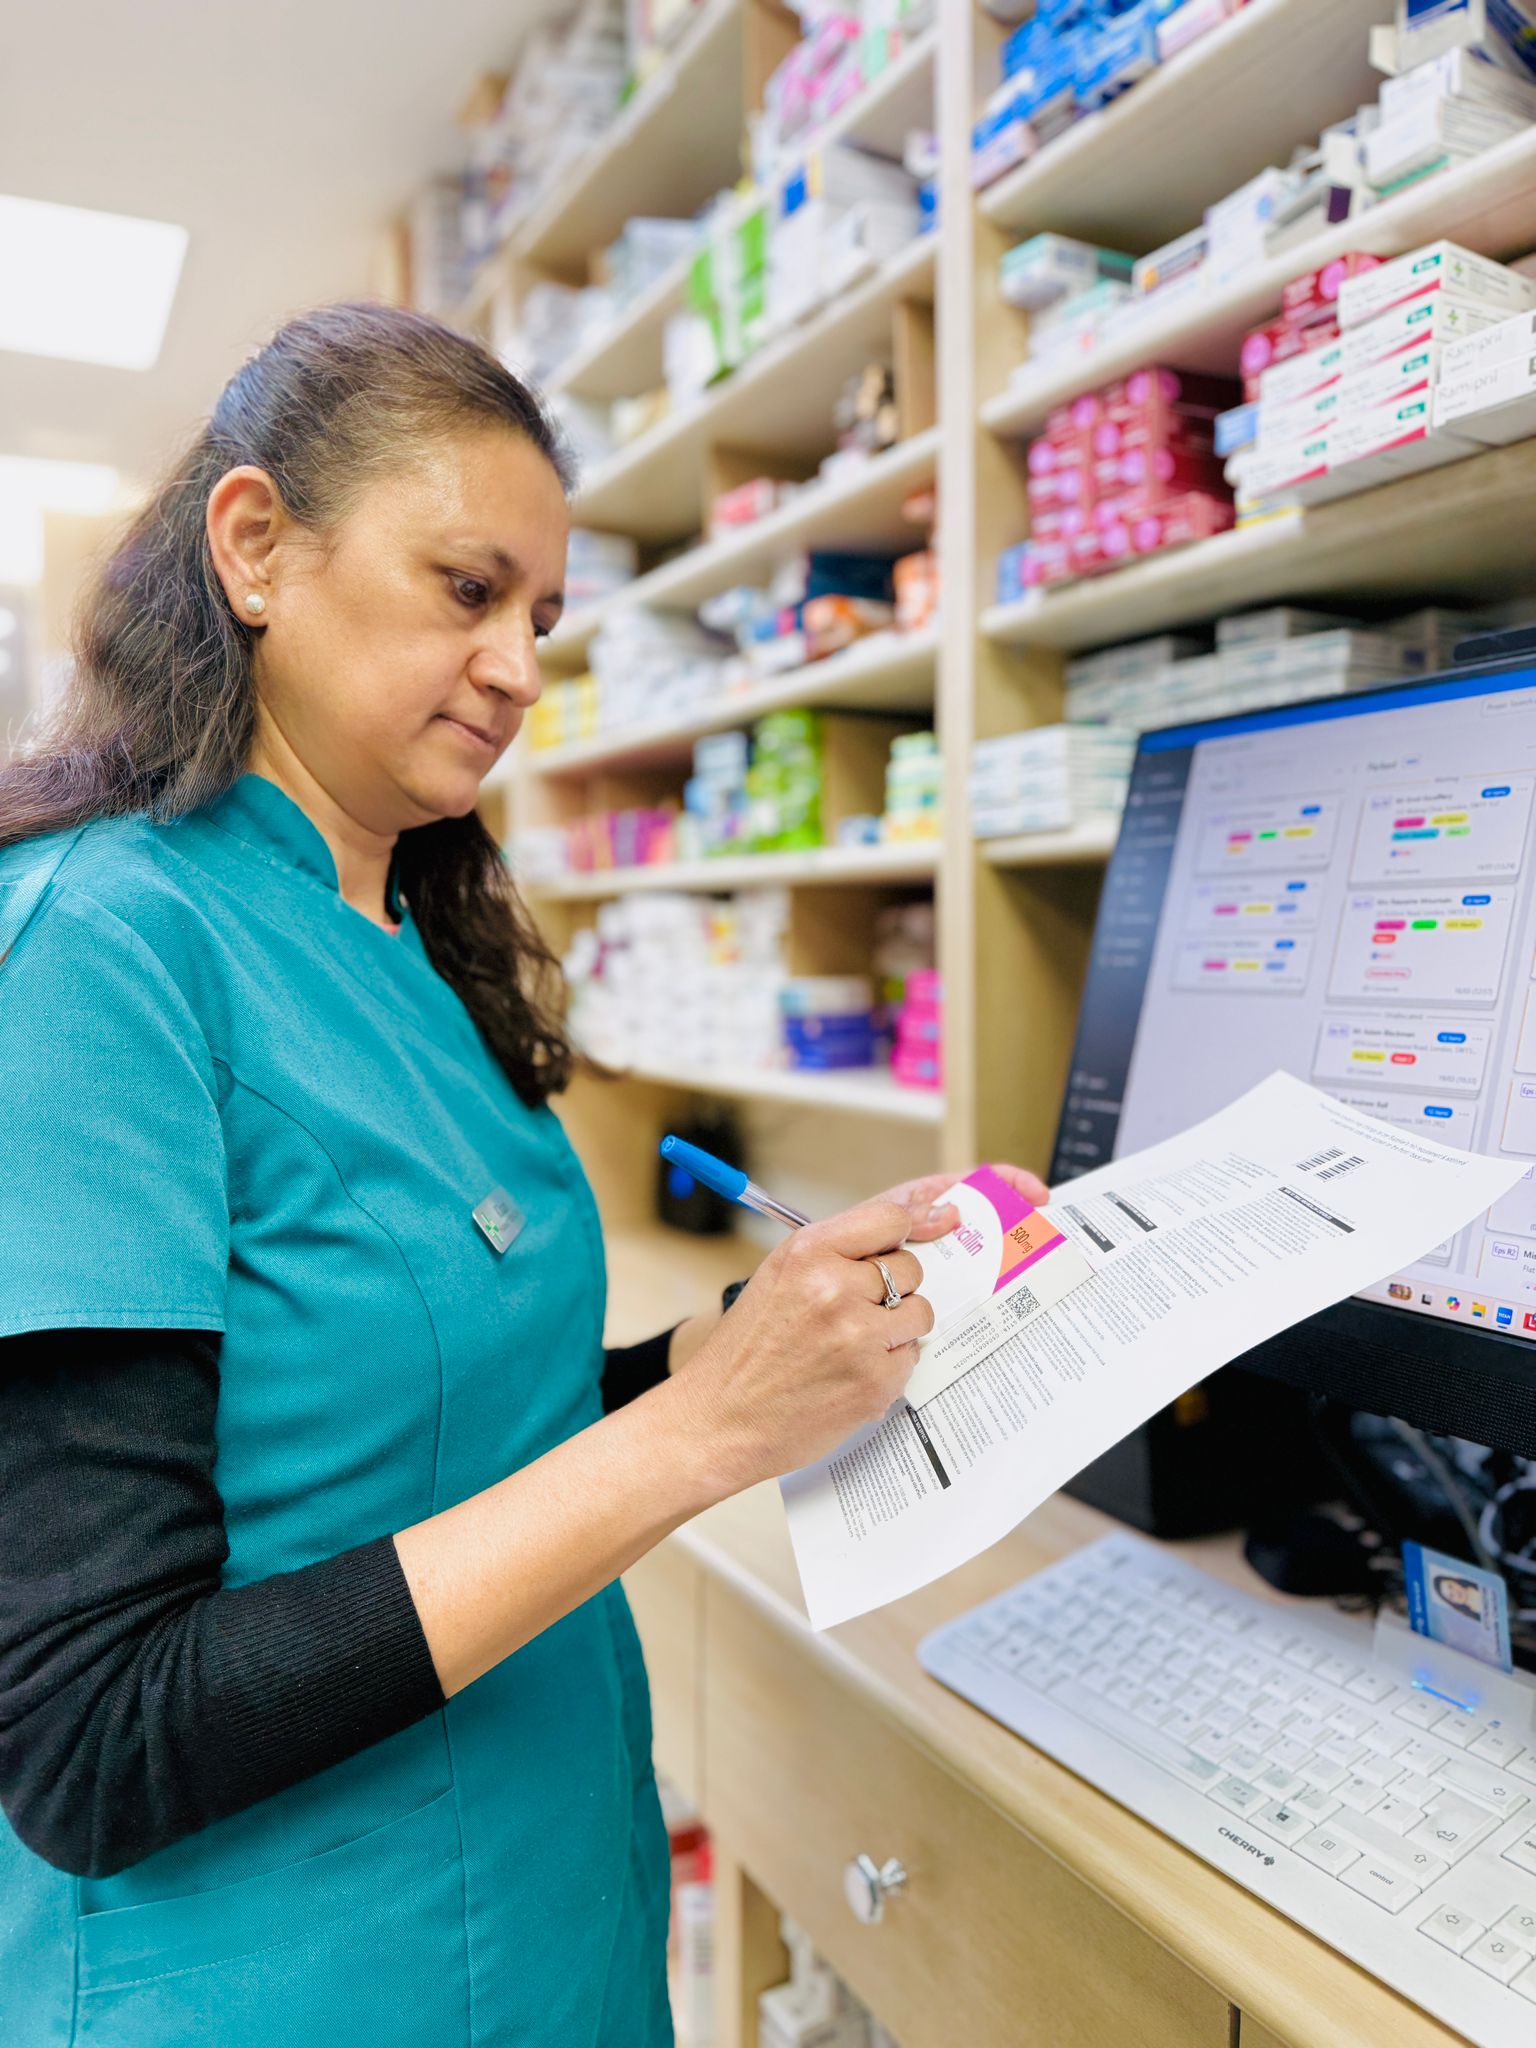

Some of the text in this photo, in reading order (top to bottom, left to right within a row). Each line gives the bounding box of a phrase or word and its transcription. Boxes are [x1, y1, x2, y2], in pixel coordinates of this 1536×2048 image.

[1494, 1246, 1505, 1256] Eps
[1499, 1311, 1511, 1320] TITAN
[1218, 1826, 1265, 1858] CHERRY
[1369, 1869, 1394, 1886] control
